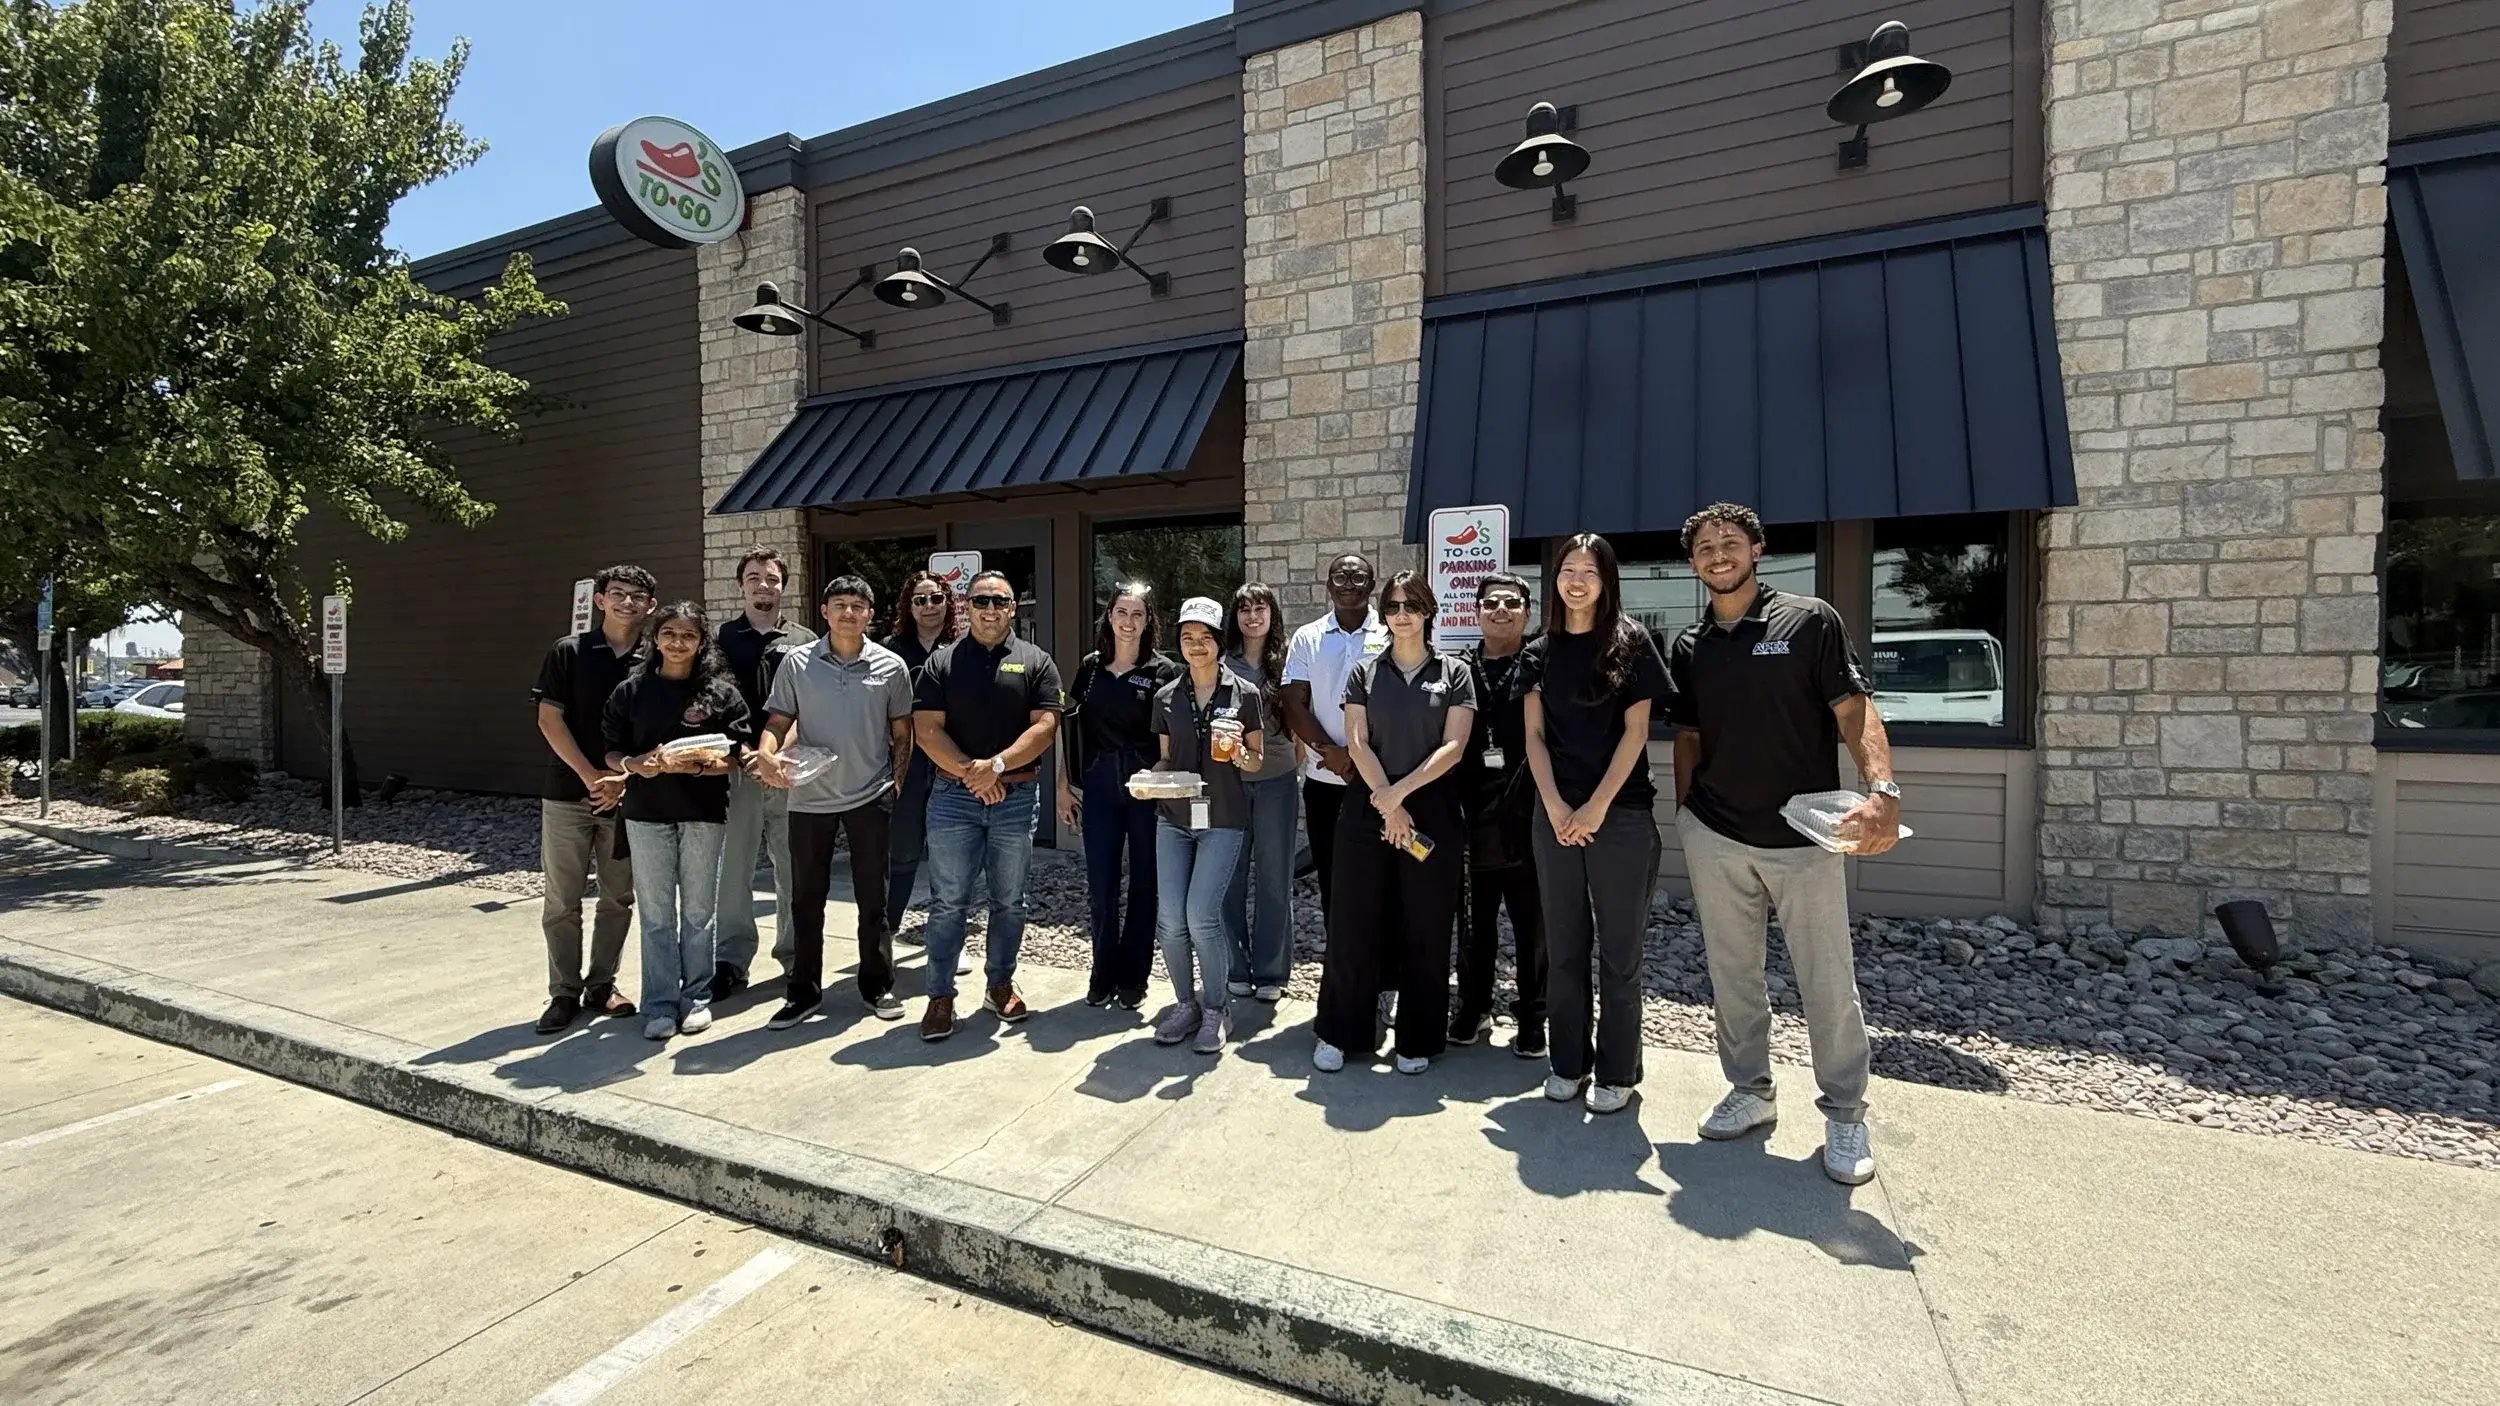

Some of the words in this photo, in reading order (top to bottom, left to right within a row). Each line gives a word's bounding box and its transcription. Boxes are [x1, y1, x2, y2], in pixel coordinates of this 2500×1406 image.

[1439, 559, 1496, 574] PARKING
[1453, 602, 1477, 613] CRUS
[1440, 616, 1458, 627] AND
[1459, 615, 1480, 626] MEL
[1752, 641, 1790, 653] APEX
